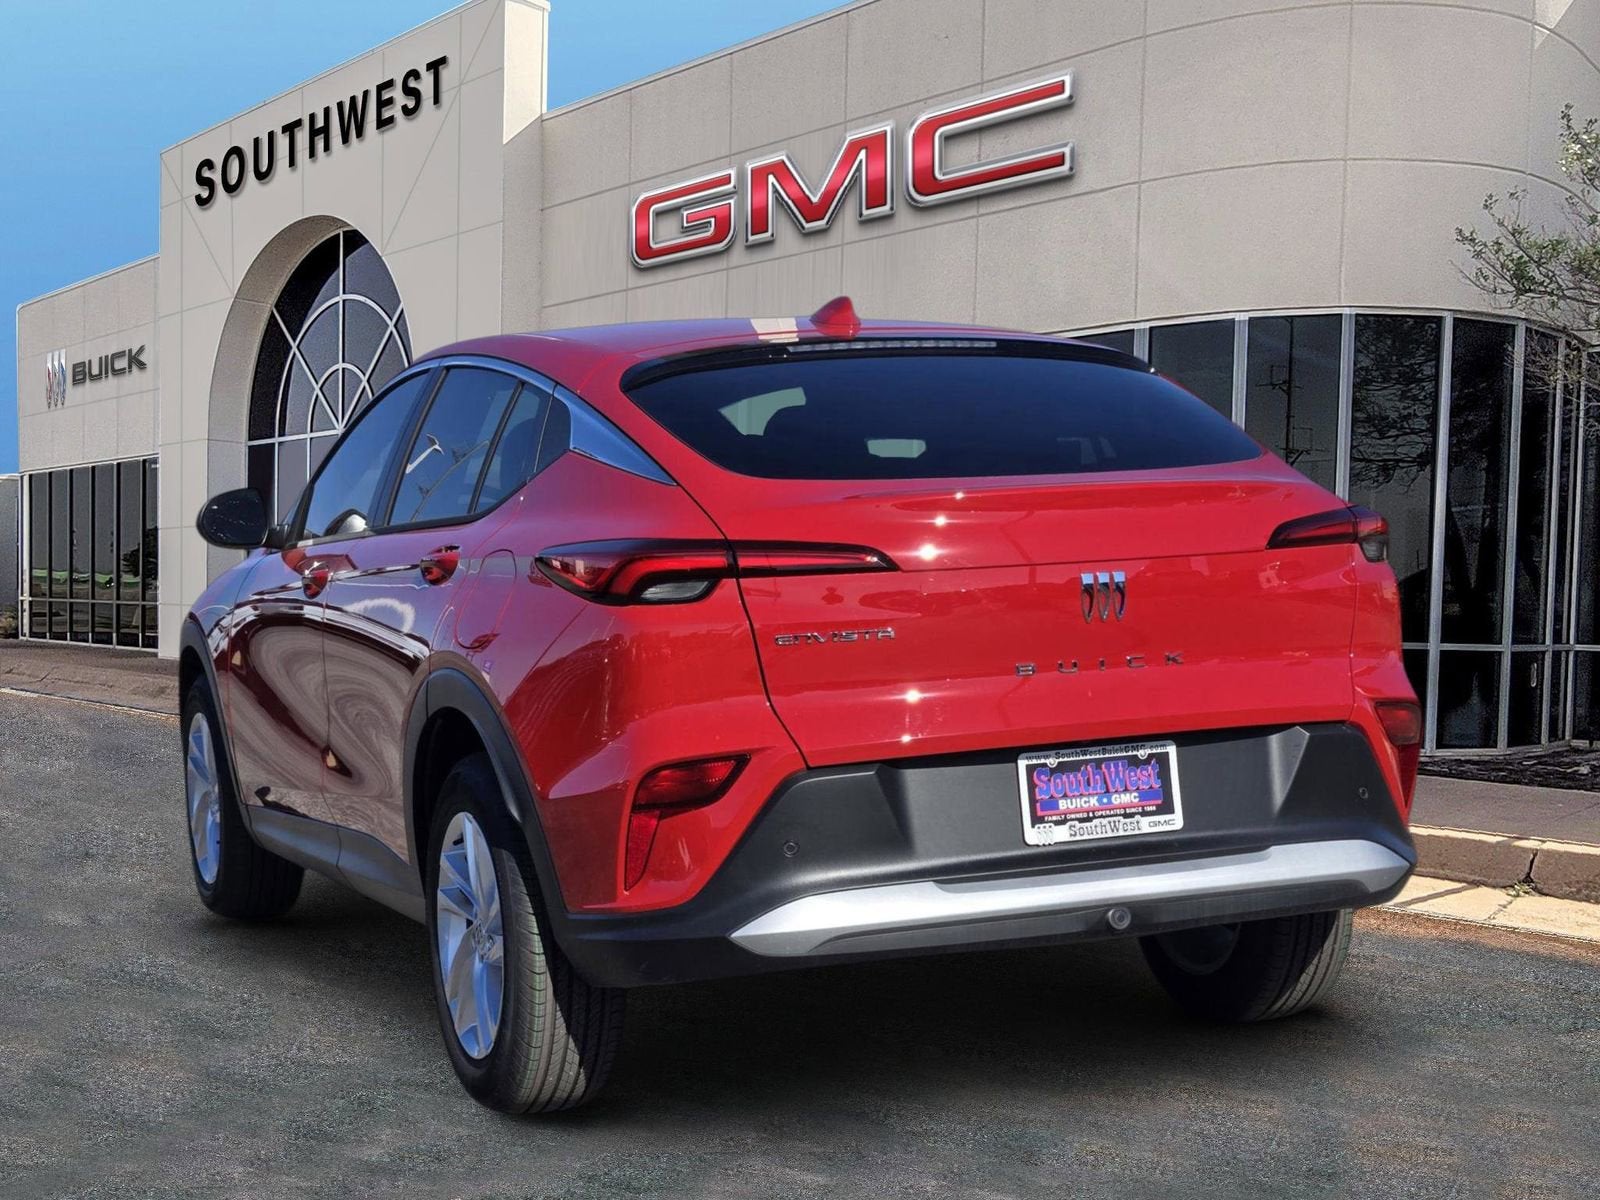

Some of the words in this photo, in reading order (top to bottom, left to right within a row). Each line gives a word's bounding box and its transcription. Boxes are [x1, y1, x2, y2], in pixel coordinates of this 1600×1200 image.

[194, 56, 449, 207] SOUTHWEST
[630, 70, 1075, 269] GMC
[71, 344, 147, 386] BUICK
[775, 626, 896, 647] ENVISTA
[1015, 651, 1185, 677] BUICK
[1034, 758, 1162, 799] SouthWest
[1059, 798, 1099, 810] BUICK
[1111, 792, 1140, 804] GMC
[1044, 814, 1065, 822] FAMILY
[1066, 811, 1088, 819] OWNED
[1095, 808, 1125, 817] OPERATED
[1069, 818, 1143, 837] SouthWest
[1148, 818, 1176, 828] GMC
